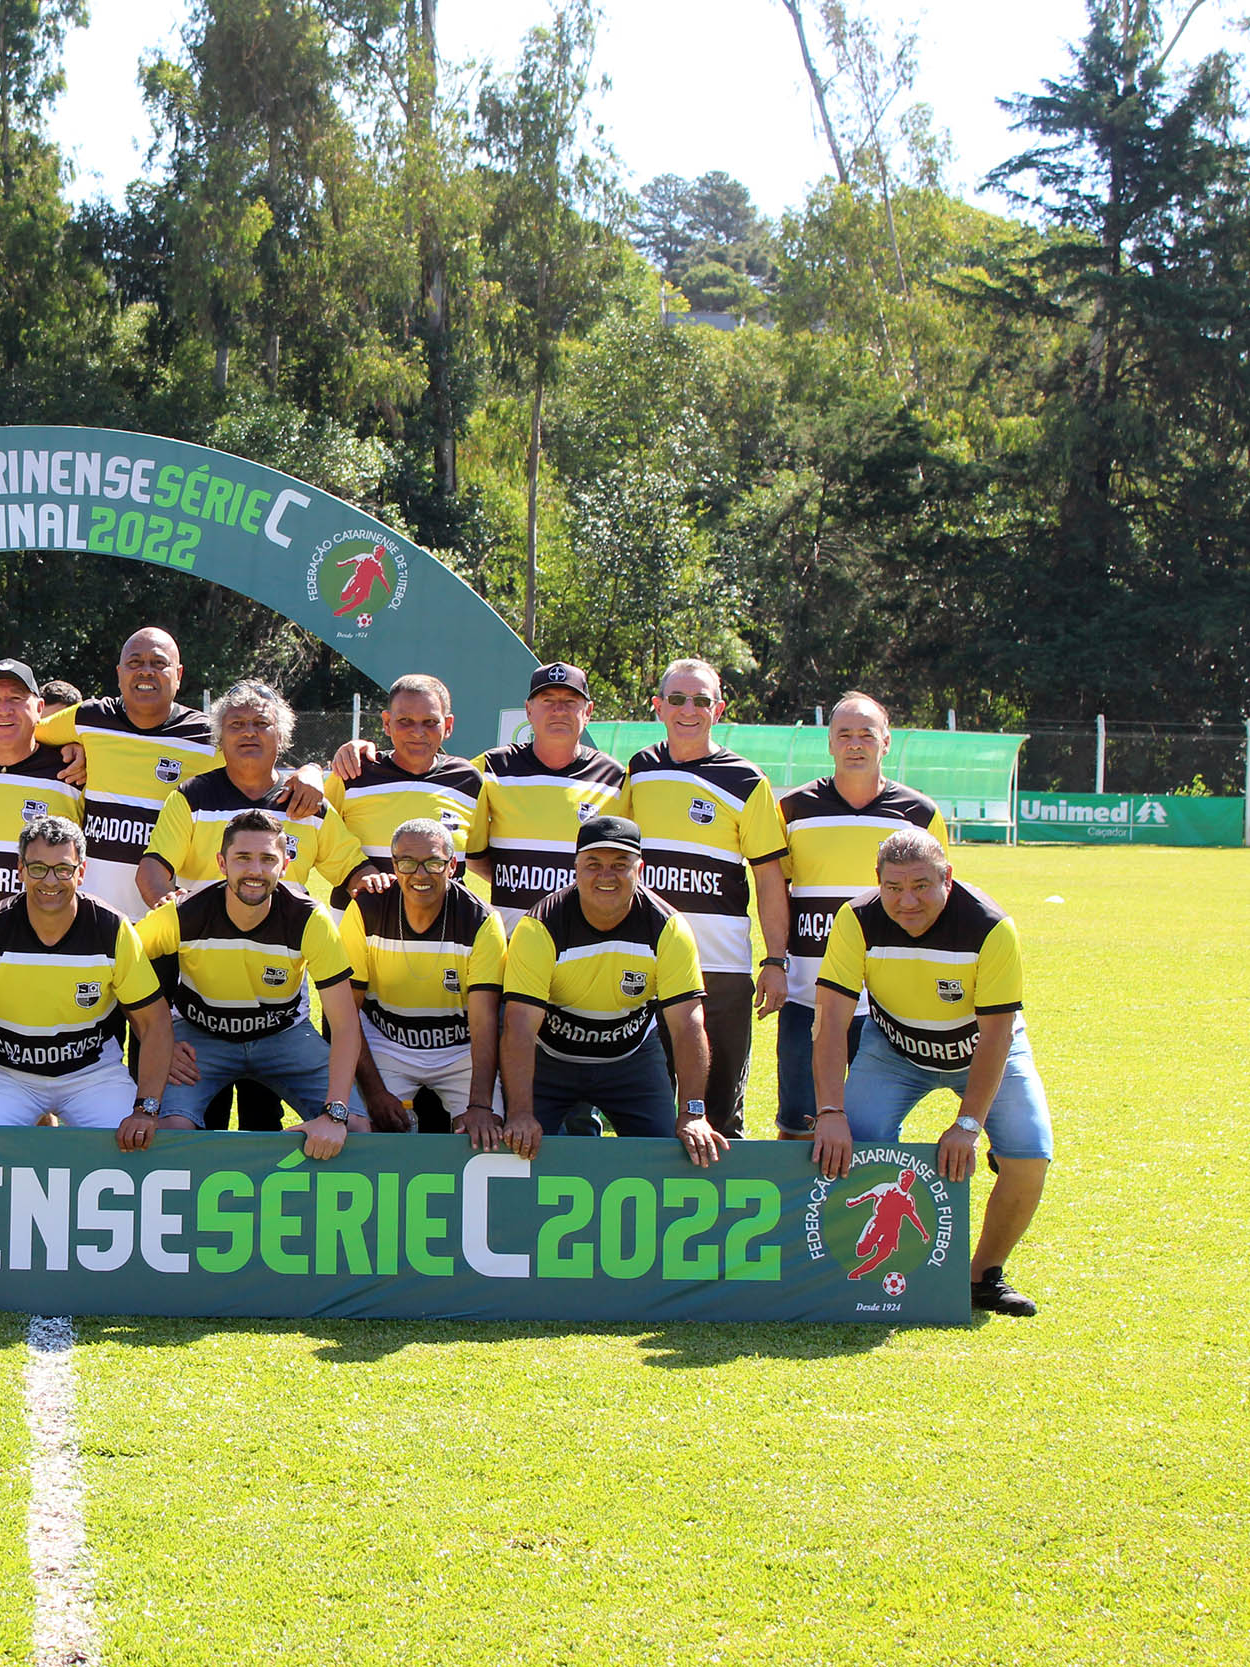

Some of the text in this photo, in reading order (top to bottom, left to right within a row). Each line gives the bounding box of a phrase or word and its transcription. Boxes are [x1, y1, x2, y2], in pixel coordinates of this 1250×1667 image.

[86, 506, 202, 570] 2022
[307, 540, 332, 601] FEDERAÇÃO
[333, 529, 400, 555] CATARINENSE
[394, 554, 407, 569] DE
[1020, 799, 1129, 823] Unimed
[1087, 827, 1127, 838] Caçador
[848, 1148, 935, 1182] ATARINENSE
[930, 1181, 949, 1203] DE
[196, 1148, 455, 1276] SÉRIE
[537, 1175, 782, 1281] 2022
[927, 1206, 952, 1267] FUTEBOL
[856, 1302, 902, 1312] Desde 1924
